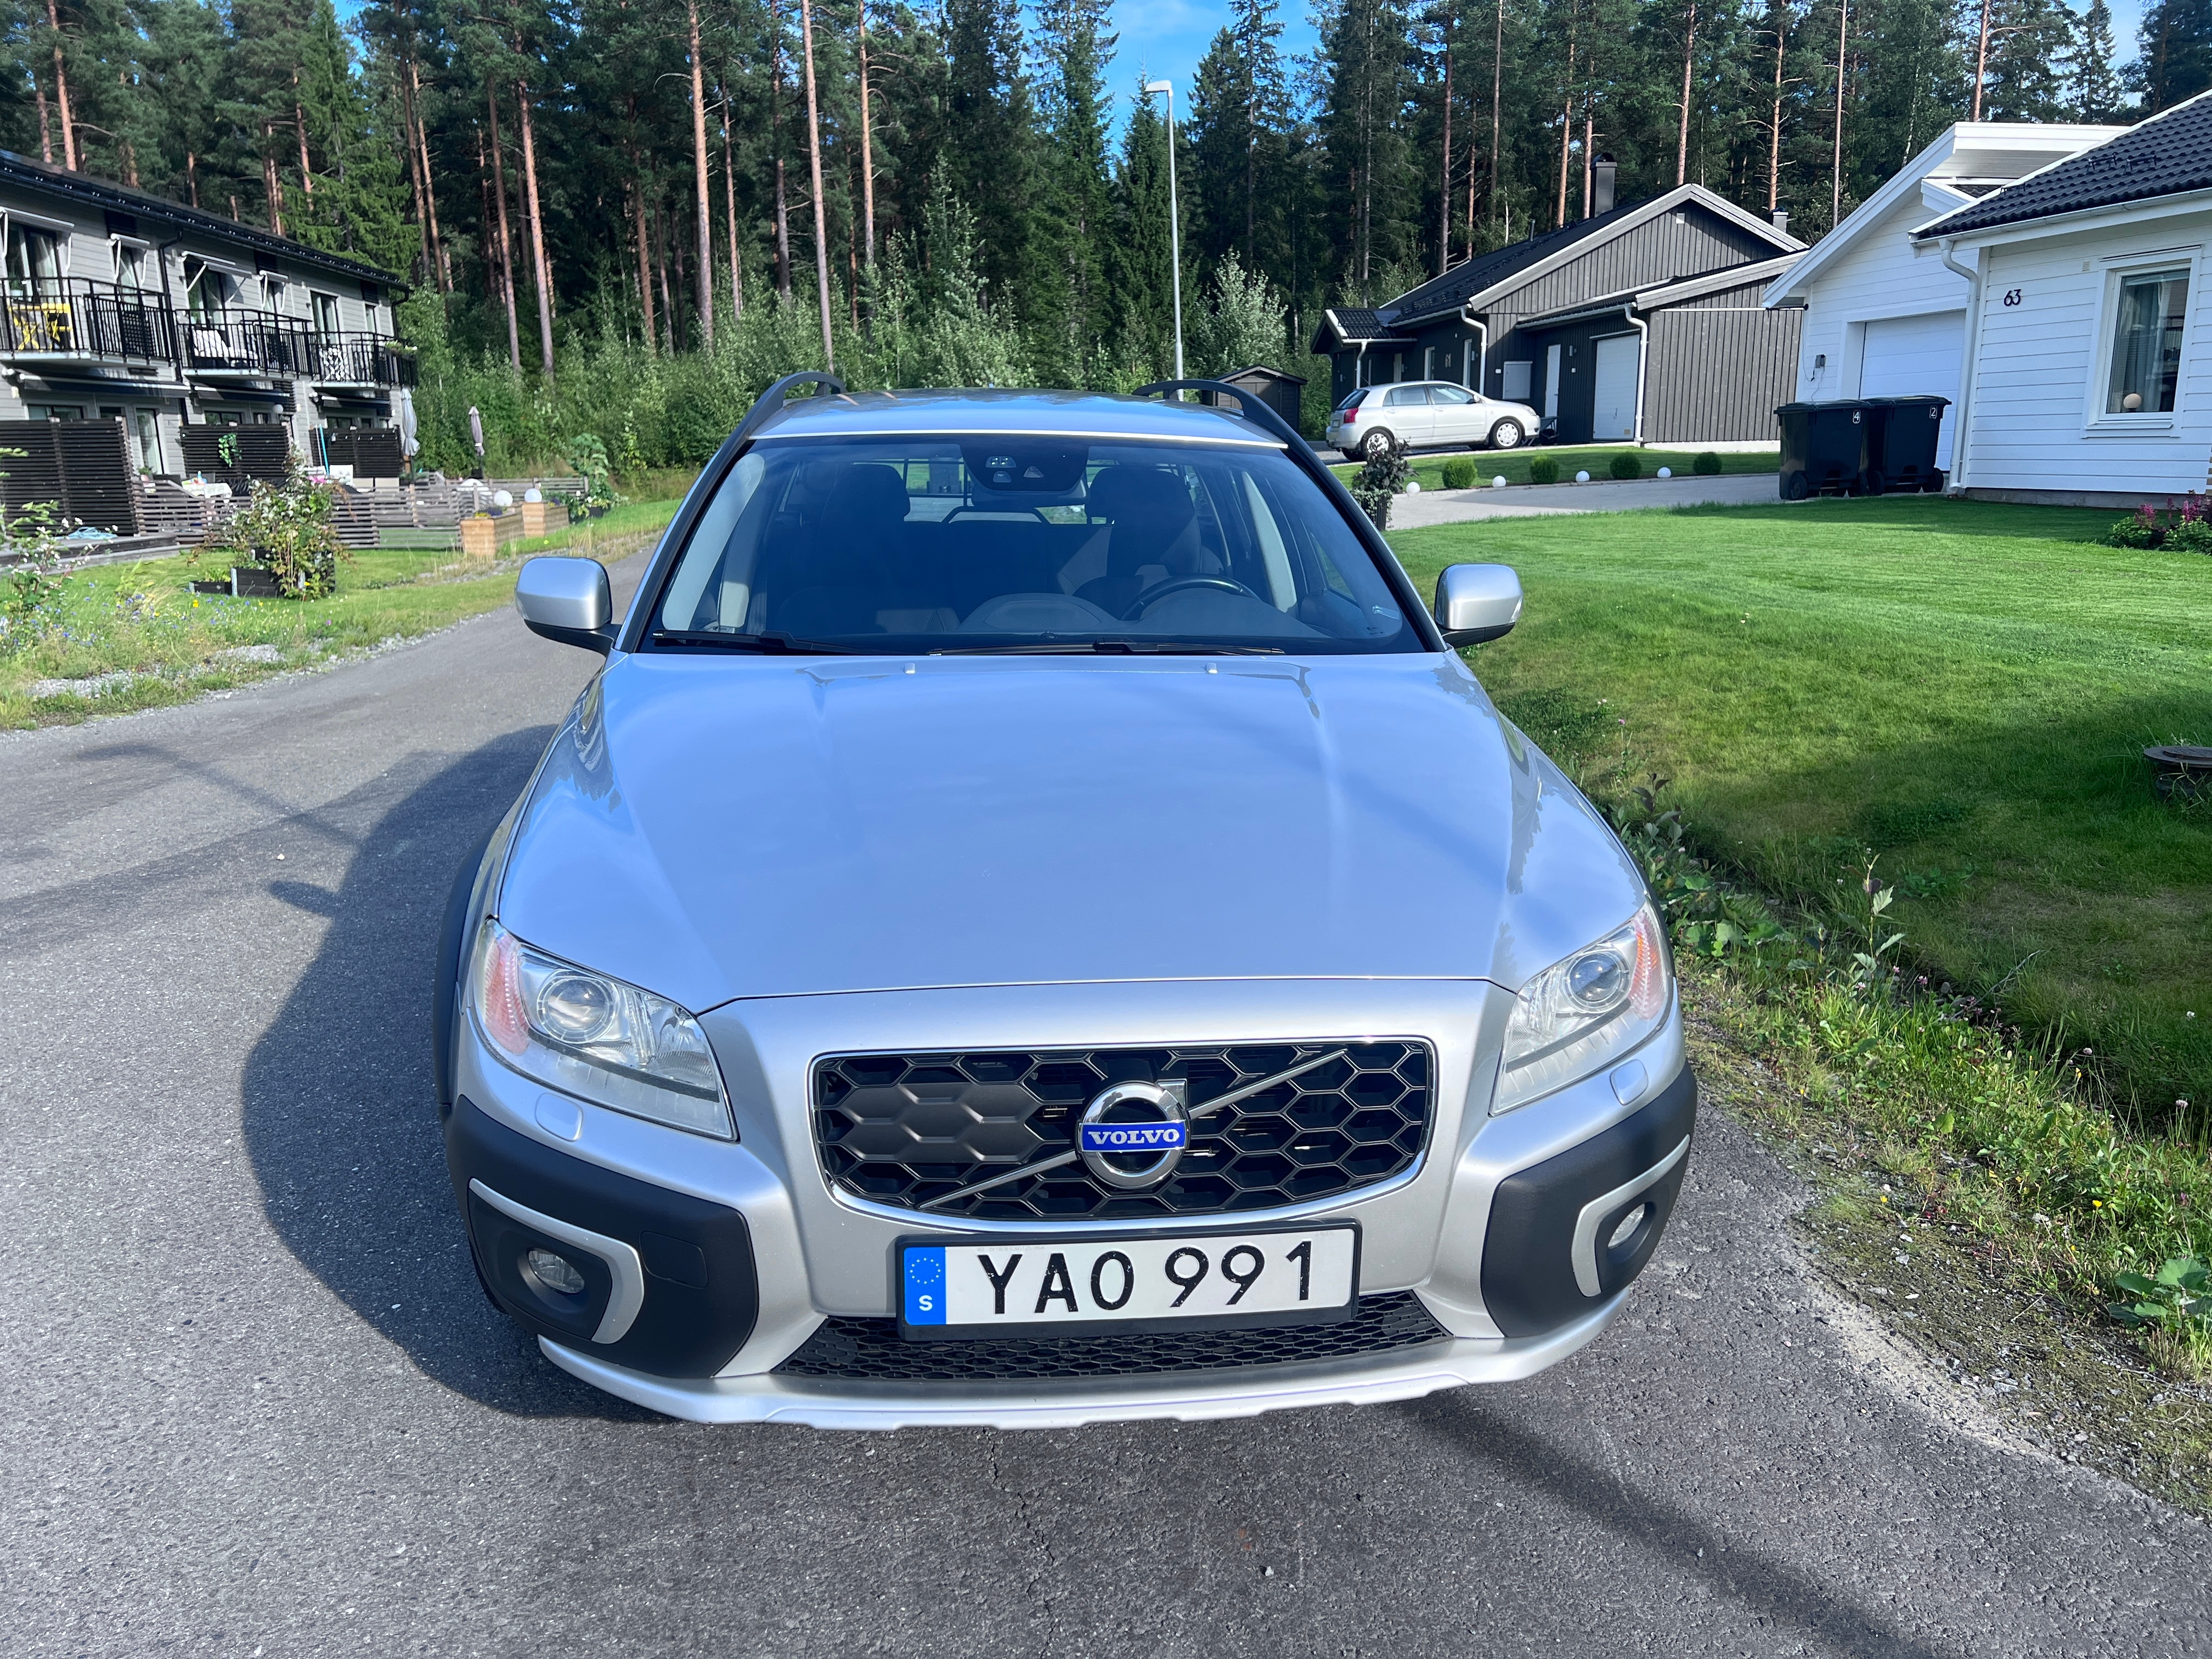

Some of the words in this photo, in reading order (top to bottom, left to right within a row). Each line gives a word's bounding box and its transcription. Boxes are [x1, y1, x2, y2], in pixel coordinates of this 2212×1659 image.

[2004, 289, 2021, 307] 63
[1854, 411, 1860, 421] 4
[1931, 407, 1936, 417] 2
[1088, 1128, 1180, 1145] VOLVO
[977, 1250, 1135, 1314] YAO
[1164, 1240, 1313, 1308] 991
[918, 1294, 933, 1312] S
